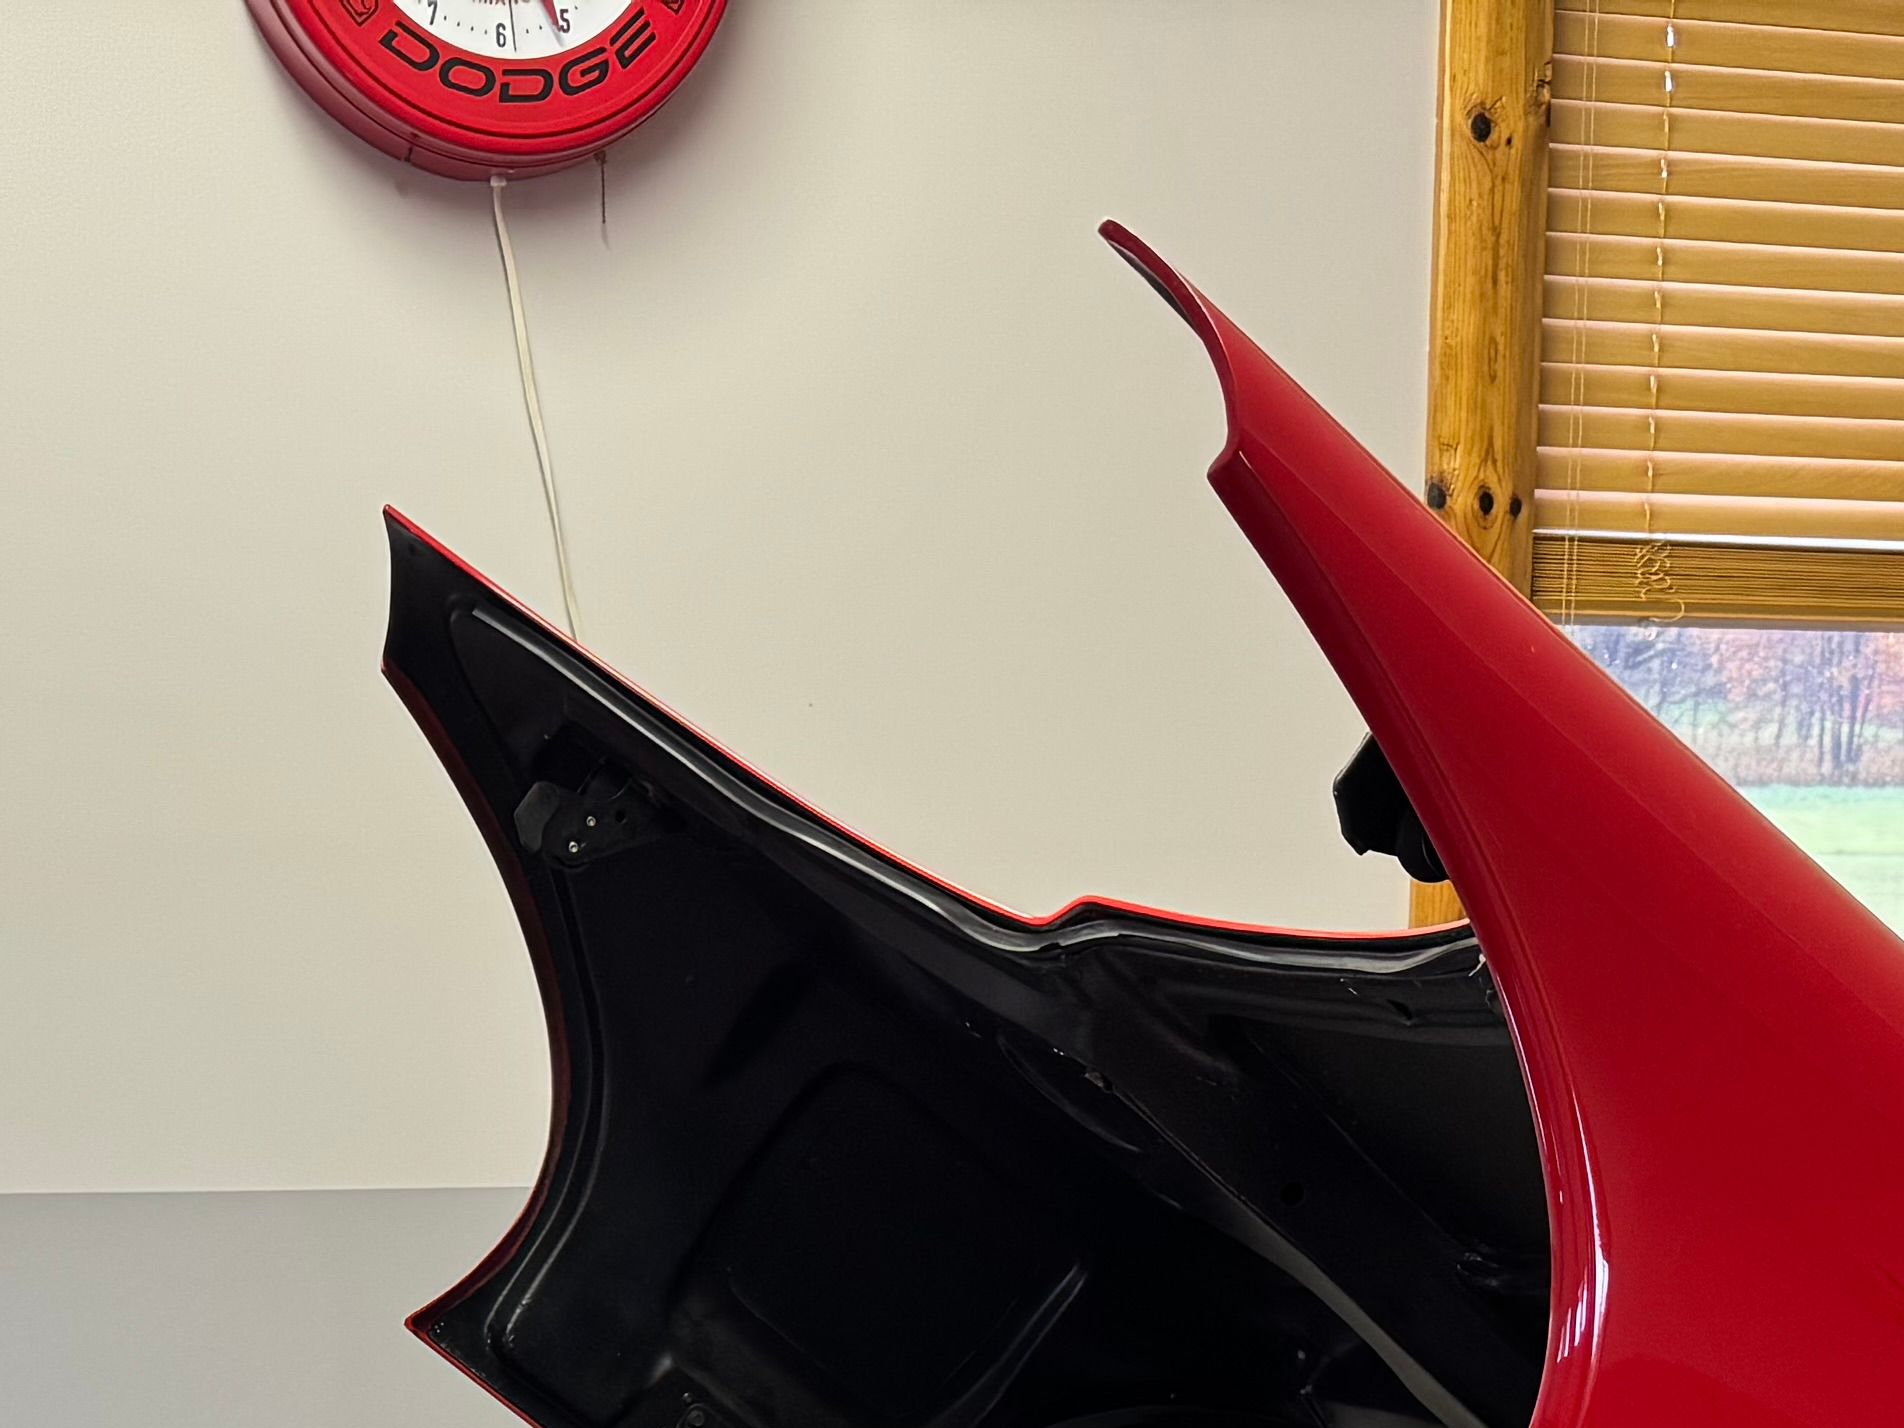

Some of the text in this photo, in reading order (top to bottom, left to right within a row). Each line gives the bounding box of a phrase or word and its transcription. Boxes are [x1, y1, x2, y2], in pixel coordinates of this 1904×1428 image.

[558, 8, 571, 34] 5
[495, 22, 507, 48] 6
[378, 7, 658, 104] DODGE
